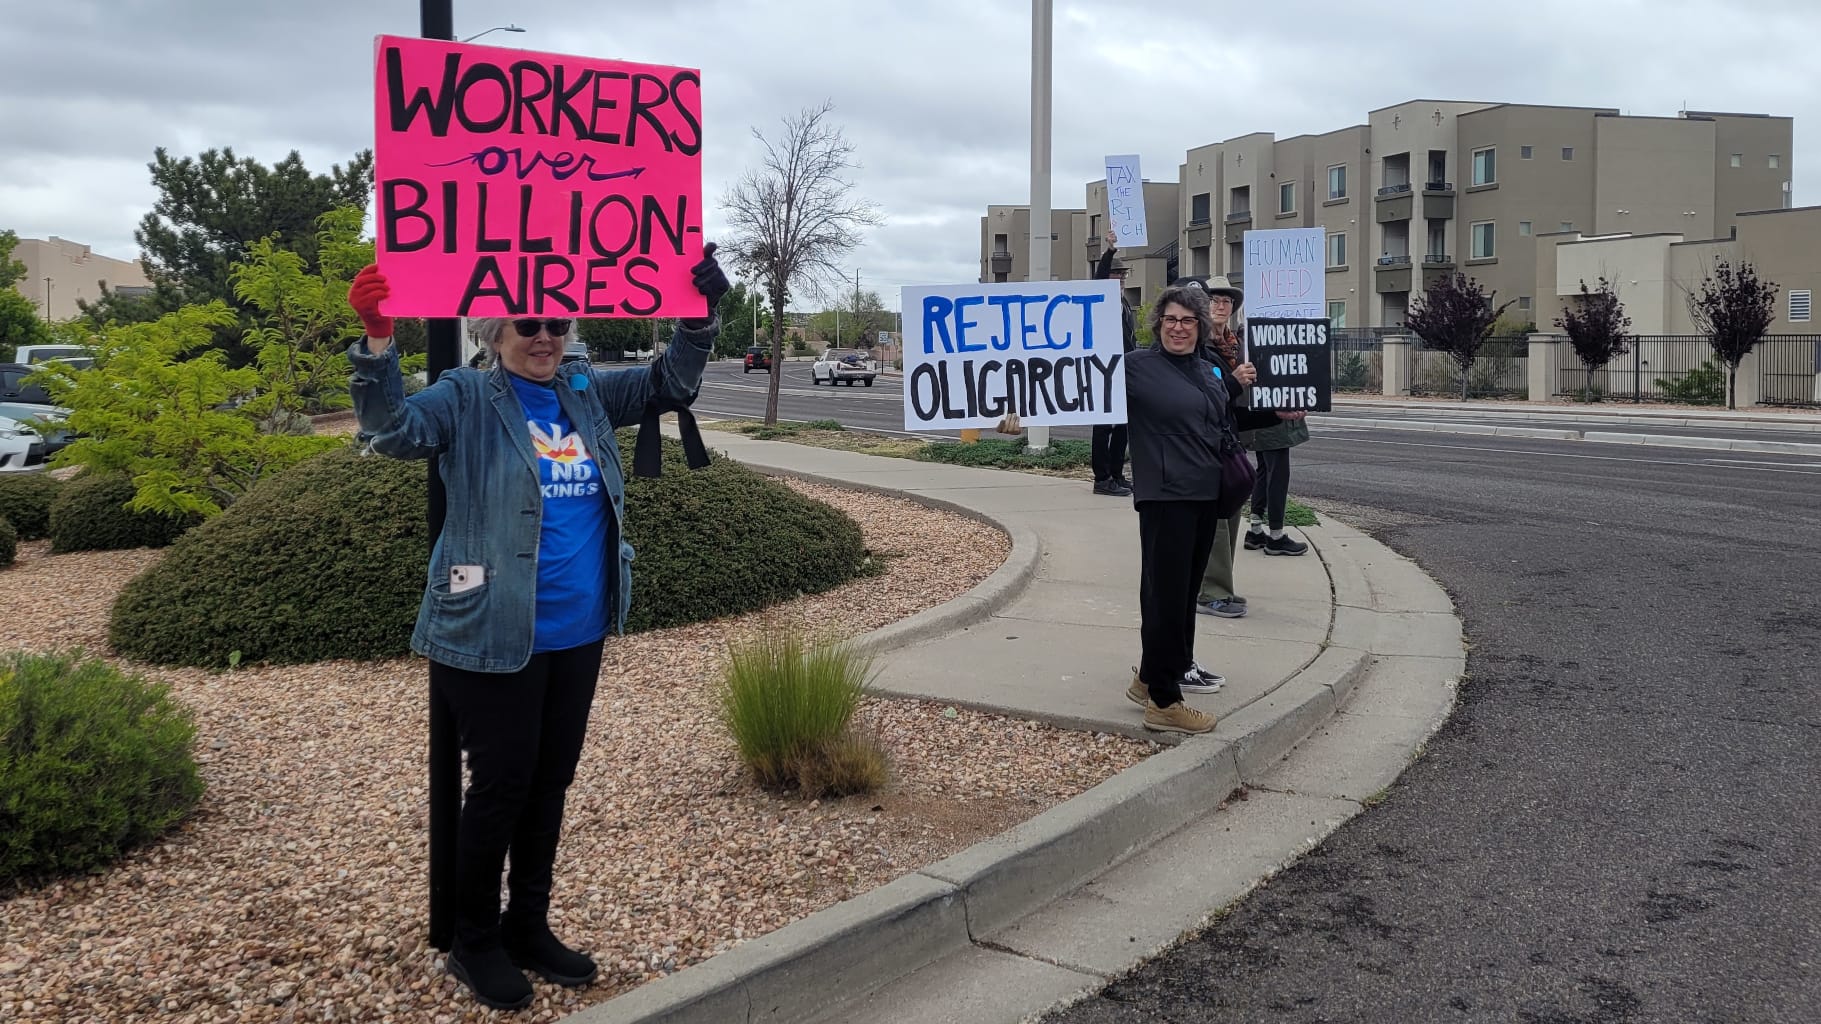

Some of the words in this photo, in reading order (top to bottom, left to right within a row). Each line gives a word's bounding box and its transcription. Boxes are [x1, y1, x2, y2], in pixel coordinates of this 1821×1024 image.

[385, 46, 702, 156] WORKERS
[477, 146, 613, 181] over
[1106, 165, 1136, 184] TAX
[1115, 186, 1132, 198] THE
[382, 178, 701, 258] BILLION-
[1249, 236, 1317, 266] HUMAN
[457, 254, 662, 316] AIRES
[1260, 269, 1313, 299] NEED
[922, 293, 1105, 354] REJECT
[1251, 324, 1327, 347] WORKERS
[1270, 354, 1308, 376] OVER
[910, 353, 1122, 421] OLIGARCHY
[1253, 386, 1317, 408] PROFITS
[541, 482, 599, 498] KINGS
